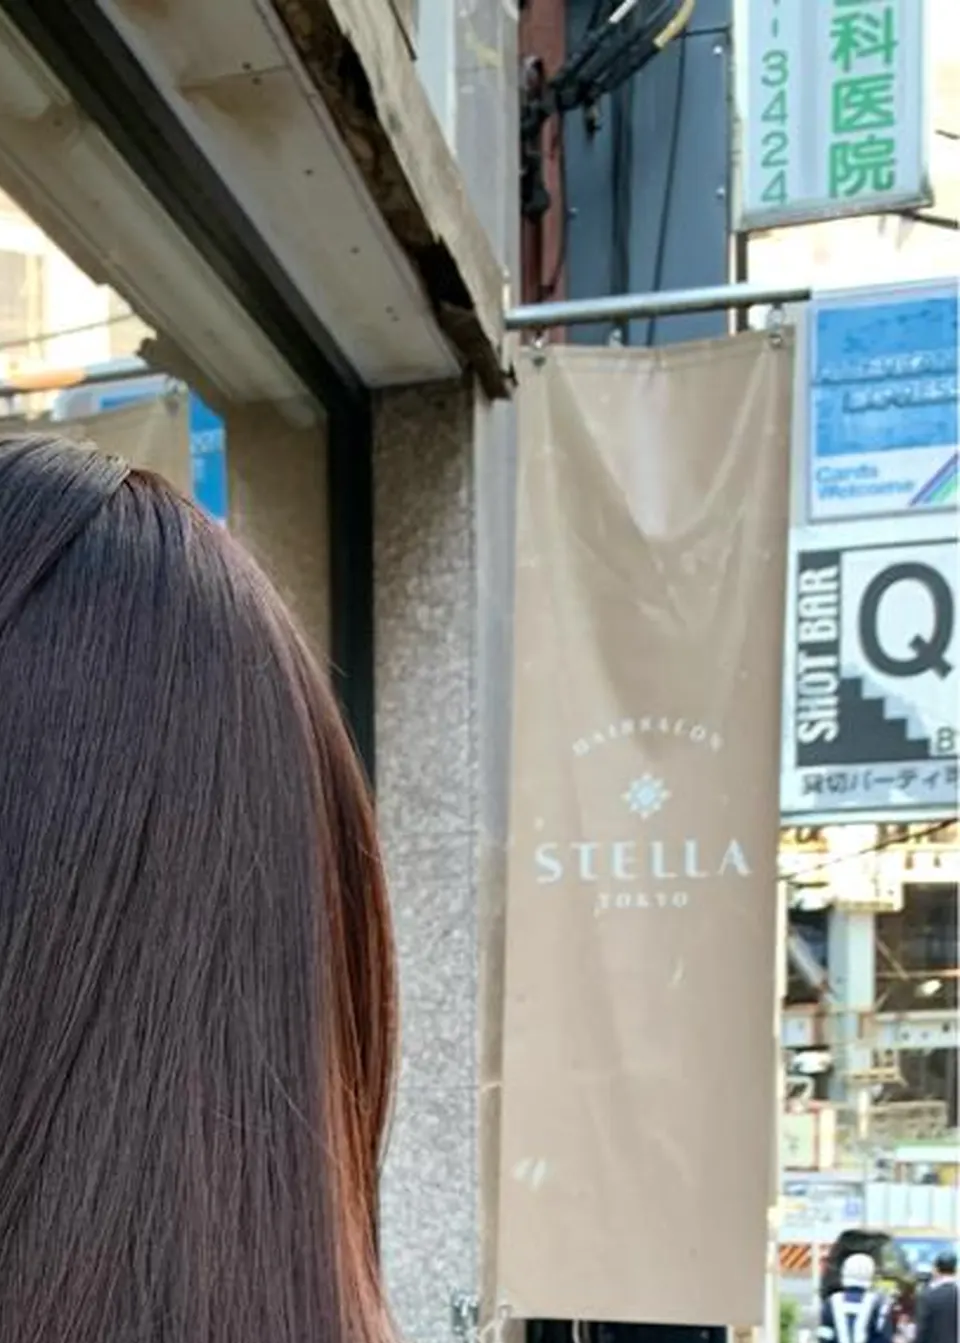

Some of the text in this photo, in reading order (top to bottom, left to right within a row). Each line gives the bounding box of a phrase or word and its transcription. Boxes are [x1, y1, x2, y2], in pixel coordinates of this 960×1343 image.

[761, 0, 789, 206] -3424
[829, 0, 898, 198] 科医院
[798, 565, 839, 744] SHOT BAR
[858, 561, 954, 680] Q
[534, 838, 753, 883] STELLA
[597, 892, 688, 908] TOKYO
